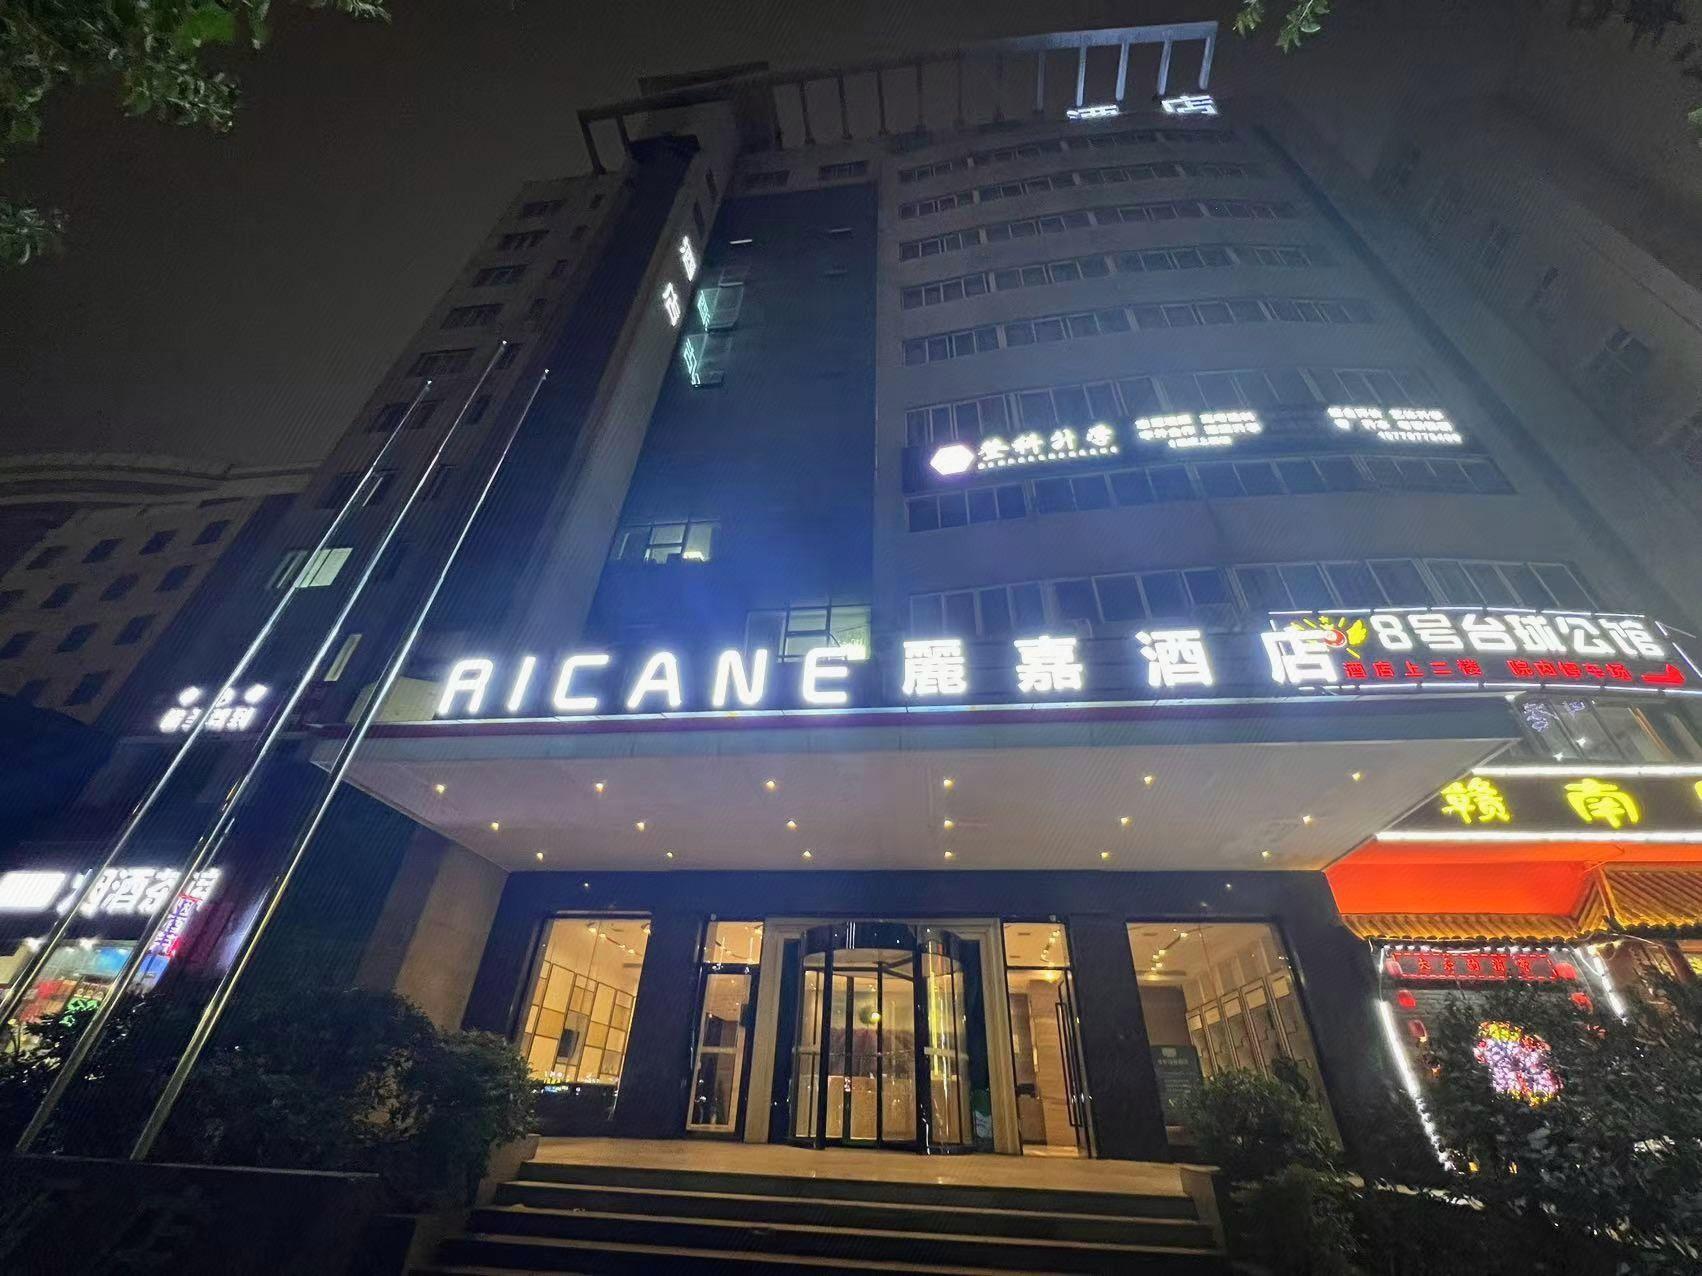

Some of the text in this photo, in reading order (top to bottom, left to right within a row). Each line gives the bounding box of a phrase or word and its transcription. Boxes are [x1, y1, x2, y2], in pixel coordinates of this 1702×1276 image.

[1369, 613, 1665, 657] 8号台球公馆
[438, 648, 848, 715] AICANE
[902, 628, 1338, 696] 麗嘉酒店
[1343, 657, 1633, 682] 酒店上二楼 院内停车场
[1441, 776, 1702, 829] 赣南
